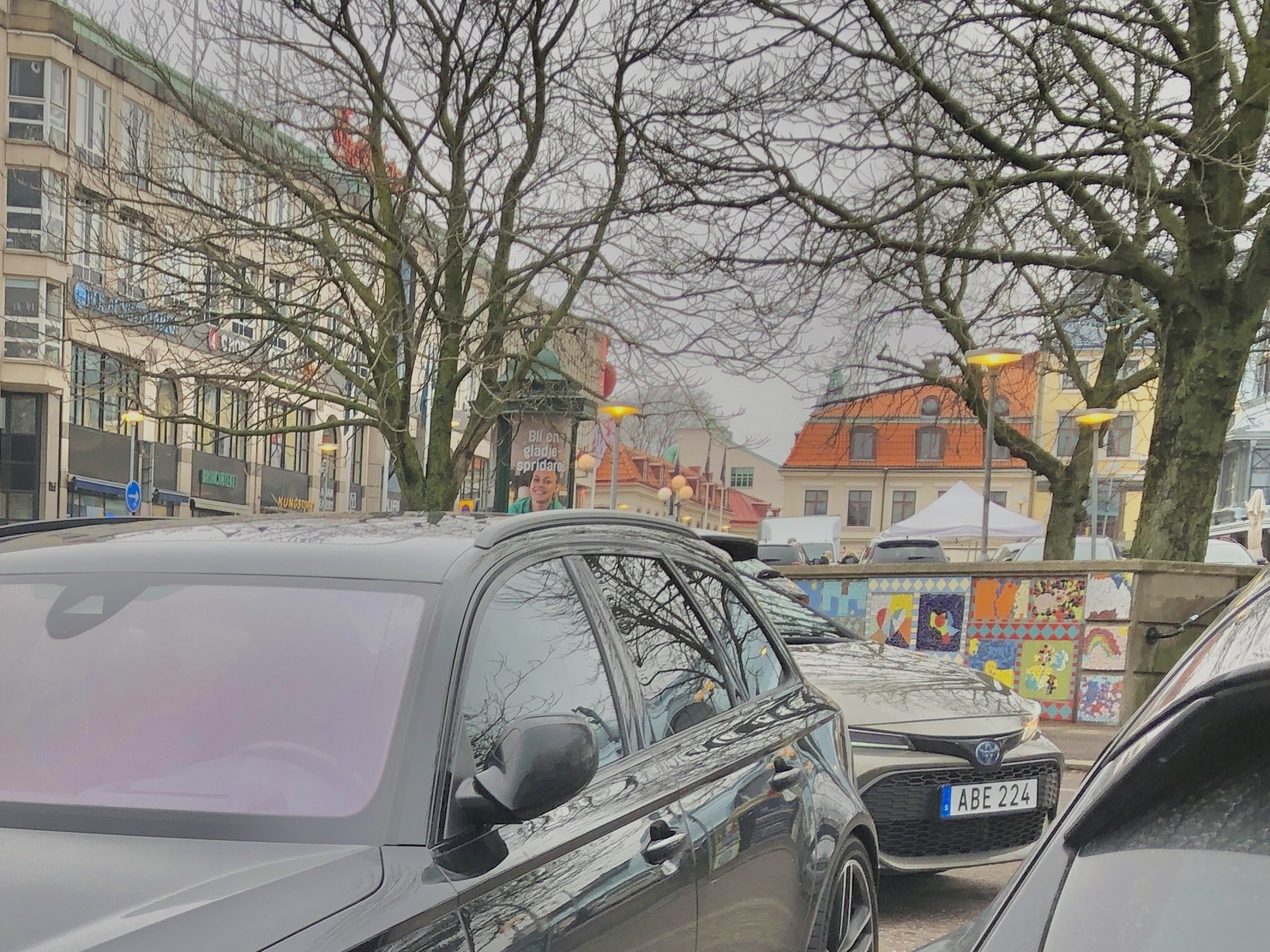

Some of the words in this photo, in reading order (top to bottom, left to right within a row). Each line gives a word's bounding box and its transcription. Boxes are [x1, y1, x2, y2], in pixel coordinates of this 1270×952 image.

[528, 430, 543, 442] Bli
[546, 432, 559, 443] en
[523, 444, 561, 459] glädje-
[958, 786, 992, 811] ABE
[998, 782, 1030, 807] 224
